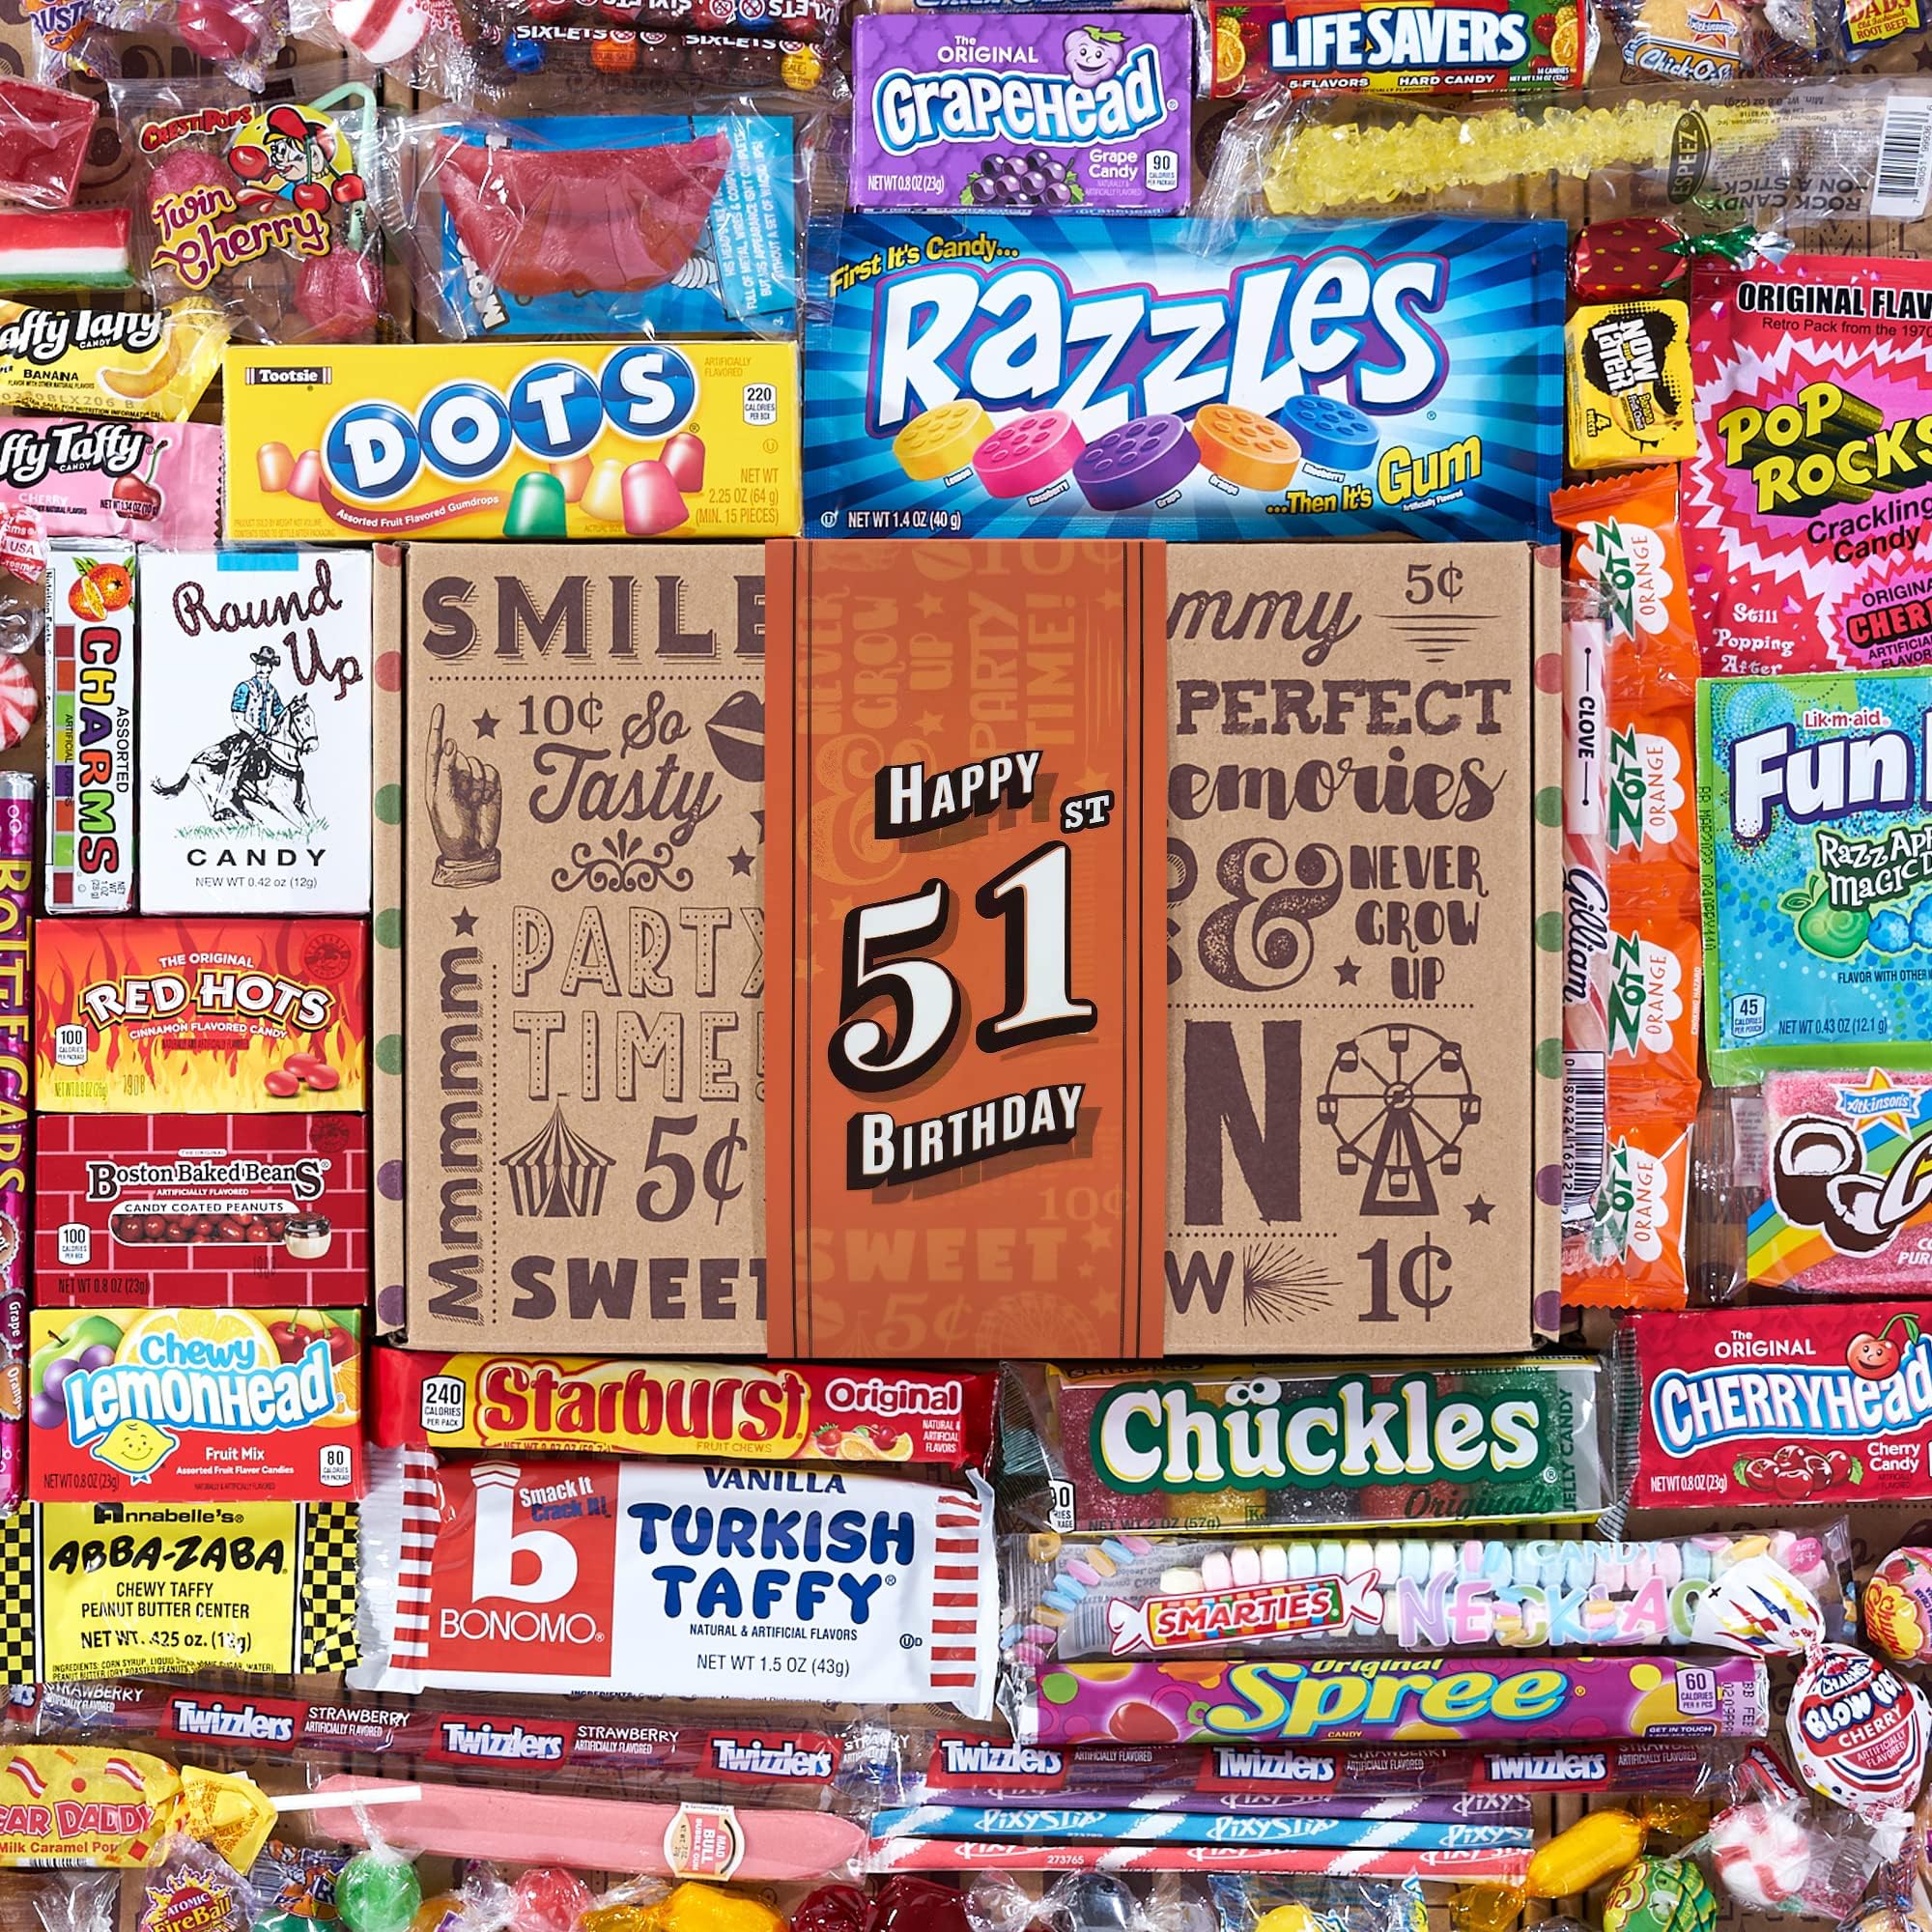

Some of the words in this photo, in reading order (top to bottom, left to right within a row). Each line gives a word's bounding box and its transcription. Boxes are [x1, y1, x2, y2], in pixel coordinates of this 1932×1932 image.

[937, 46, 1038, 64] ORIGINAL
[954, 35, 977, 46] The
[1271, 15, 1363, 69] LIFE
[1366, 8, 1528, 66] SAVERS
[1399, 75, 1440, 86] HARD
[1443, 74, 1496, 85] CANDY
[1090, 150, 1138, 165] Grape
[1090, 164, 1138, 180] Candy
[153, 187, 233, 240] Twin
[1711, 194, 1788, 212] CANDY
[1794, 194, 1862, 212] ROCK
[153, 214, 325, 286] Cherry
[829, 258, 882, 298] First
[887, 244, 921, 271] It's
[926, 234, 1019, 263] Candy...
[1762, 317, 1800, 331] Retro
[1804, 320, 1837, 333] Pack
[1841, 323, 1871, 334] from
[1876, 324, 1897, 336] the
[23, 369, 79, 382] BANANA
[259, 369, 318, 383] Tootsie
[747, 387, 772, 402] 220
[343, 352, 676, 490] DOTS
[1718, 382, 1844, 468] POP
[740, 469, 761, 483] NET
[762, 469, 779, 483] WT
[1342, 485, 1372, 509] It's
[1378, 436, 1481, 505] Gum
[10, 541, 35, 555] USA
[1833, 526, 1920, 563] Candy
[1633, 535, 1655, 615] ORANGE
[172, 559, 343, 637] Round
[1732, 604, 1778, 624] Still
[422, 575, 765, 667] SMILE
[1713, 628, 1795, 657] Popping
[284, 628, 363, 701] Up
[969, 591, 1019, 759] PARTY
[1720, 655, 1784, 676] After
[1176, 679, 1512, 735] PERFECT
[519, 691, 604, 735] 10¢
[621, 690, 692, 759] So
[1578, 696, 1595, 759] CLOVE
[79, 627, 121, 873] CHARMS
[117, 706, 129, 793] ASSORTED
[528, 742, 723, 846] Tasty
[890, 752, 1039, 825] HAPPY
[1646, 747, 1664, 827] ORANGE
[1734, 726, 1908, 838] Fun
[1065, 795, 1110, 829] ST
[187, 849, 327, 867] CANDY
[1350, 844, 1489, 897] NEVER
[1355, 899, 1480, 952] GROW
[158, 953, 186, 969] THE
[189, 952, 255, 968] ORIGINAL
[843, 844, 1093, 1072] 51
[1390, 956, 1445, 1000] UP
[1645, 955, 1667, 1035] ORANGE
[85, 979, 185, 1022] RED
[200, 974, 329, 1024] HOTS
[1740, 999, 1758, 1015] 45
[61, 1031, 82, 1044] 100
[129, 1022, 188, 1040] CINNAMON
[191, 1022, 247, 1034] FLAVORED
[249, 1026, 287, 1039] CANDY
[862, 1086, 1082, 1176] BIRTHDAY
[88, 1162, 174, 1200] Boston
[183, 1162, 241, 1183] Baked
[125, 1203, 167, 1212] CANDY
[172, 1203, 221, 1212] COATED
[226, 1203, 284, 1212] PEANUTS
[1634, 1162, 1654, 1242] ORANGE
[63, 1229, 86, 1243] 100
[794, 1227, 1068, 1284] SWEET
[140, 1333, 255, 1369] Chewy
[1715, 1340, 1816, 1359] ORIGINAL
[1731, 1330, 1753, 1341] The
[426, 1383, 461, 1405] 240
[485, 1366, 805, 1440] Starburst
[829, 1381, 962, 1414] Original
[424, 1406, 461, 1417] CALORIES
[1559, 1388, 1574, 1456] CANDY
[206, 1447, 238, 1461] Fruit
[241, 1447, 265, 1461] Mix
[327, 1450, 344, 1465] 80
[696, 1441, 728, 1452] FRUIT
[730, 1443, 772, 1454] CHEWS
[1867, 1442, 1920, 1458] Cherry
[176, 1465, 213, 1476] Assorted
[214, 1465, 234, 1476] Fruit
[235, 1465, 260, 1476] Flavor
[261, 1465, 294, 1476] Candies
[703, 1466, 847, 1494] VANILLA
[1869, 1457, 1920, 1473] Candy
[519, 1479, 576, 1508] Smack
[578, 1476, 593, 1496] It
[1562, 1459, 1577, 1513] JELLY
[94, 1503, 238, 1524] Annabelle's
[627, 1502, 915, 1565] TURKISH
[48, 1534, 284, 1575] ABBA-ZABA
[1526, 1541, 1662, 1567] CANDY
[116, 1582, 165, 1598] CHEWY
[170, 1582, 213, 1597] TAFFY
[652, 1564, 882, 1625] TAFFY
[81, 1603, 134, 1619] PEANUT
[137, 1603, 191, 1618] BUTTER
[196, 1603, 250, 1619] CENTER
[440, 1608, 596, 1643] BONOMO
[1155, 1591, 1331, 1635] SMARTIES
[690, 1624, 737, 1637] NATURAL
[741, 1626, 748, 1637] &
[752, 1626, 807, 1639] ARTIFICIAL
[810, 1627, 858, 1641] FLAVORS
[696, 1654, 727, 1670] NET
[730, 1655, 755, 1672] WT
[759, 1656, 781, 1672] 1.5
[786, 1657, 808, 1674] OZ
[811, 1657, 850, 1678] (43g)
[1686, 1674, 1707, 1690] 60
[1822, 1662, 1871, 1695] CHARMS
[1206, 1661, 1567, 1738] Spree
[1804, 1690, 1872, 1740] BLOW
[174, 1700, 294, 1742] Twizzlers
[308, 1707, 412, 1727] STRAWBERRY
[1838, 1704, 1902, 1747] CHERRY
[442, 1723, 563, 1761] Twizzlers
[577, 1725, 679, 1744] STRAWBERRY
[713, 1740, 833, 1778] Twizzlers
[942, 1741, 1062, 1775] Twizzlers
[1212, 1747, 1335, 1782] Twizzlers
[1491, 1748, 1606, 1781] Twizzlers
[0, 1842, 25, 1854] Milk
[30, 1842, 88, 1854] Caramel
[701, 1829, 716, 1864] BULL
[716, 1835, 726, 1858] MAD
[1047, 1855, 1084, 1864] 273765
[167, 1892, 210, 1918] ATOMIC
